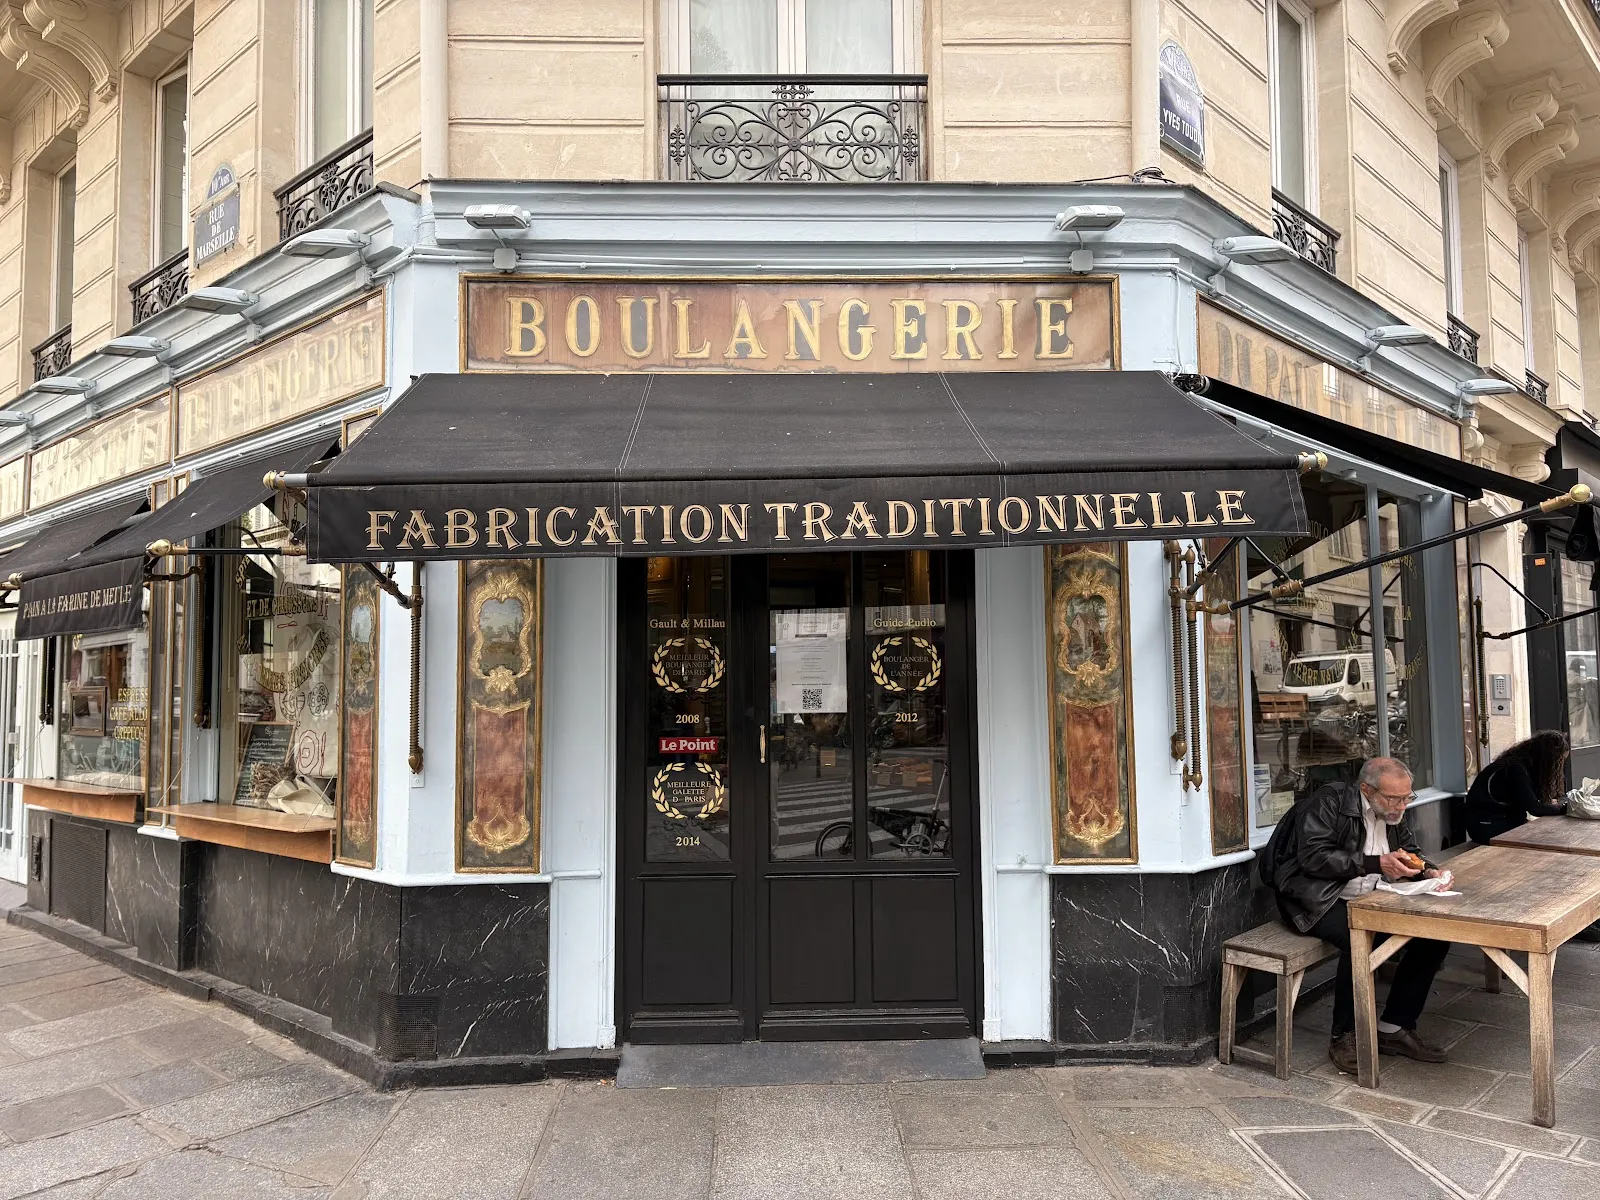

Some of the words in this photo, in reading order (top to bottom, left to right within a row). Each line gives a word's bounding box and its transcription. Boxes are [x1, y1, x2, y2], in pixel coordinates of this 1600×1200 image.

[1163, 107, 1181, 132] YVES
[1181, 119, 1203, 145] TOUDI
[209, 203, 225, 224] RUE
[211, 220, 222, 237] DE
[196, 225, 235, 262] MARSEILLE
[503, 294, 1075, 360] BOULANGERIE
[365, 502, 751, 551] FABRICATION
[764, 489, 1255, 542] TRADITIONNELLE
[23, 601, 40, 619] PAIN
[47, 597, 56, 615] LA
[57, 591, 89, 613] FARINE
[90, 589, 102, 609] DE
[246, 598, 257, 618] ET
[259, 597, 270, 617] DE
[649, 618, 677, 629] Gault
[680, 618, 690, 629] &
[693, 618, 726, 629] Millau
[874, 618, 904, 628] Guide
[907, 618, 937, 628] Pudlo
[890, 669, 923, 677] L'ANNÉE
[675, 714, 700, 724] 2008
[895, 712, 918, 723] 2012
[661, 739, 677, 751] Le
[679, 738, 716, 751] Point
[676, 836, 701, 847] 2014
